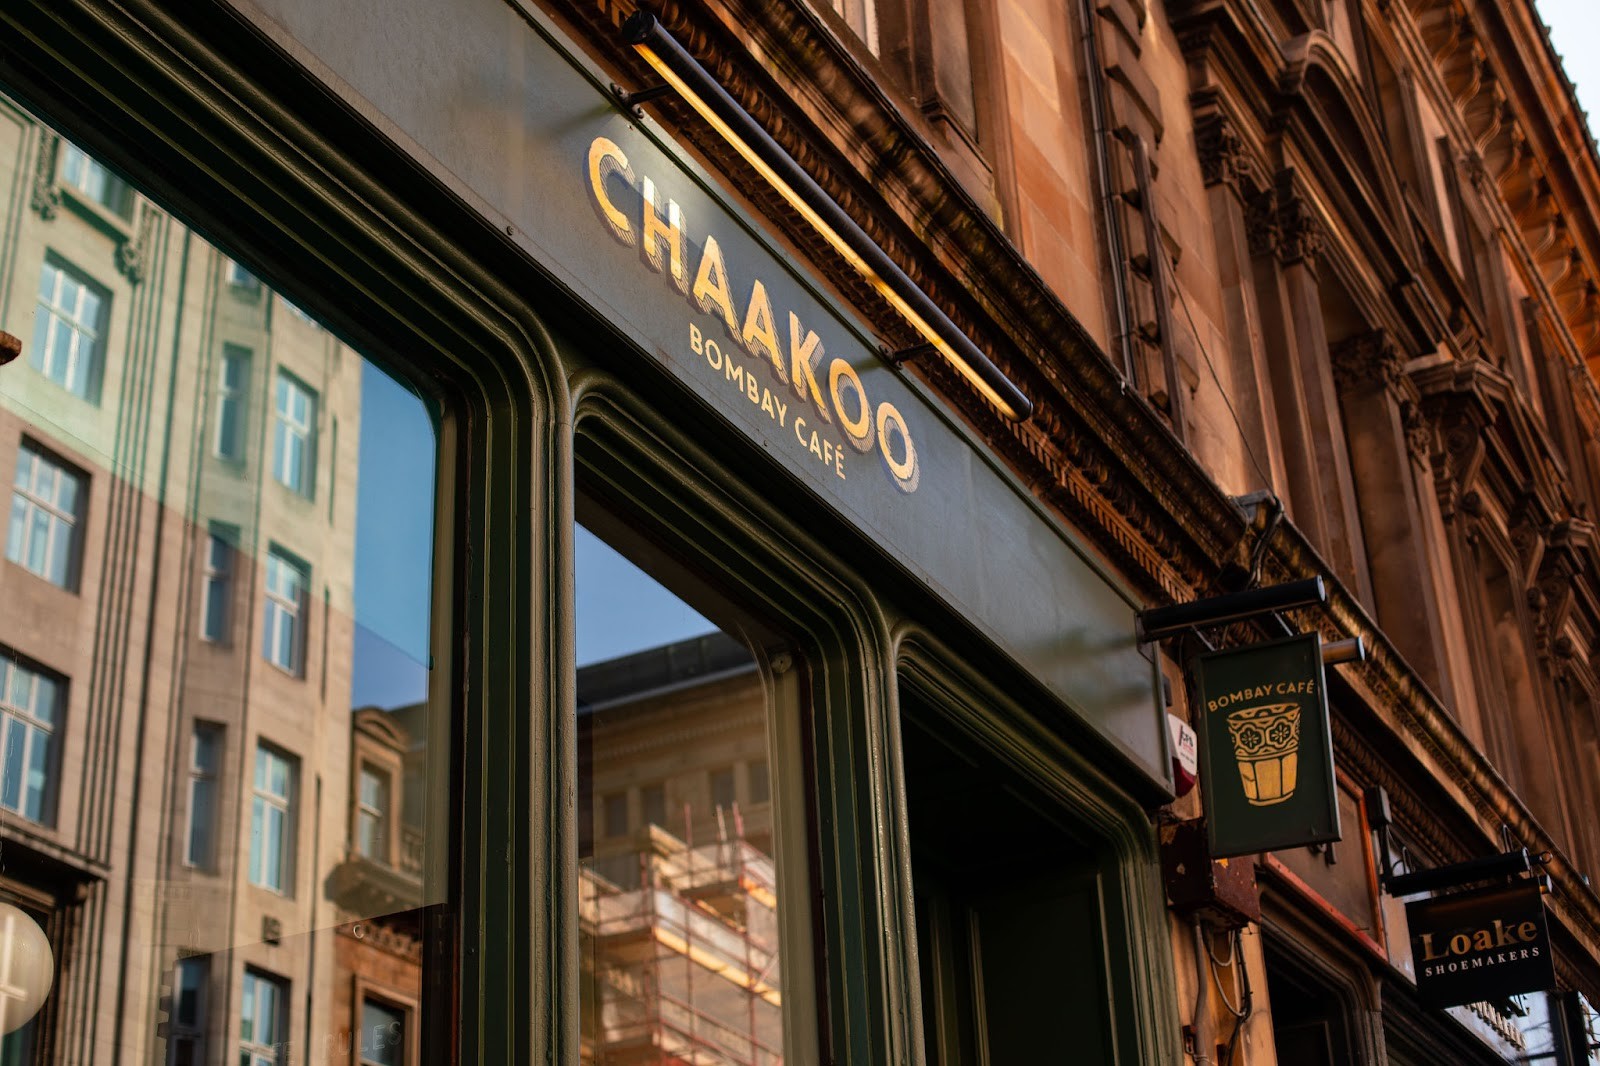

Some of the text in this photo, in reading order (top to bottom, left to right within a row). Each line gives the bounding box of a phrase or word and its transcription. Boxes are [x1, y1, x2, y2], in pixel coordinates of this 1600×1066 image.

[583, 136, 919, 492] CHAAKOO
[689, 322, 847, 480] BOMBAY CAFÉ
[1207, 679, 1315, 712] BOMBAY CAFÉ
[1419, 919, 1538, 962] Loake
[1425, 947, 1540, 977] SHOEMAKERS
